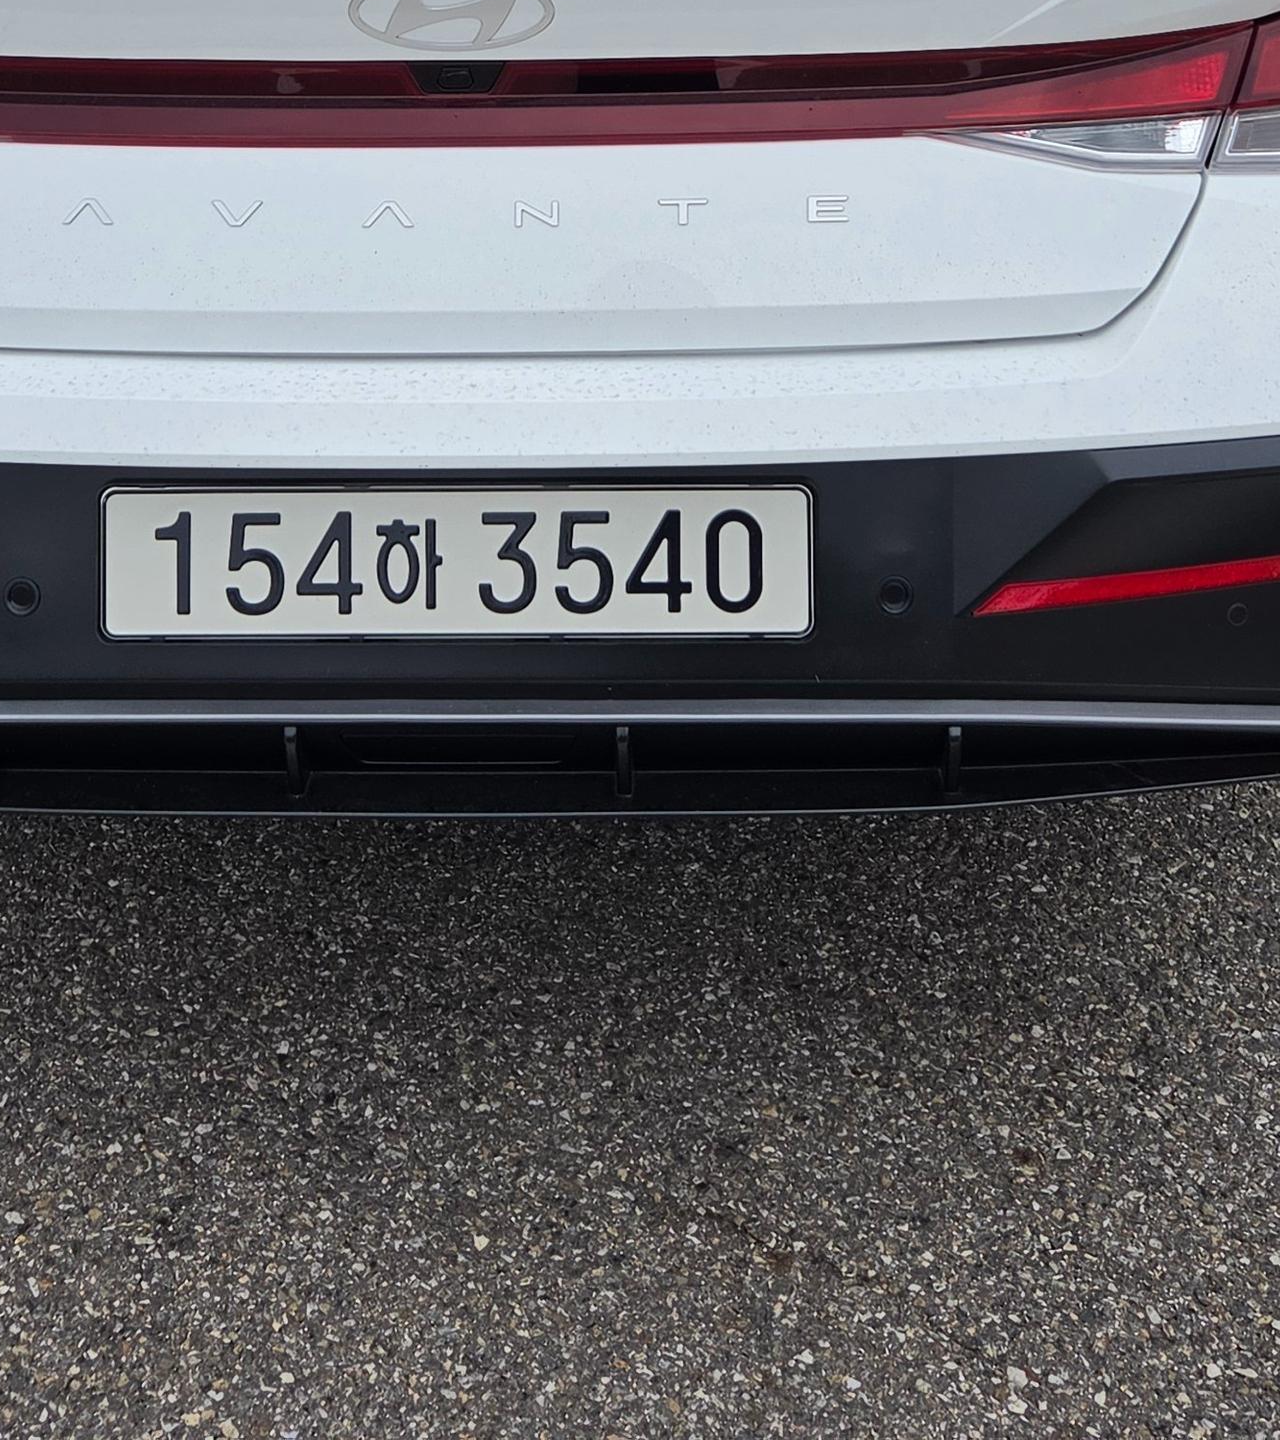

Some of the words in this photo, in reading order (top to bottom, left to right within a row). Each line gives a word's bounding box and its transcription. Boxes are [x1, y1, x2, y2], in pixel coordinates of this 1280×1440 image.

[61, 193, 852, 229] AVANTE
[154, 509, 444, 617] 154하
[477, 508, 764, 616] 3540
